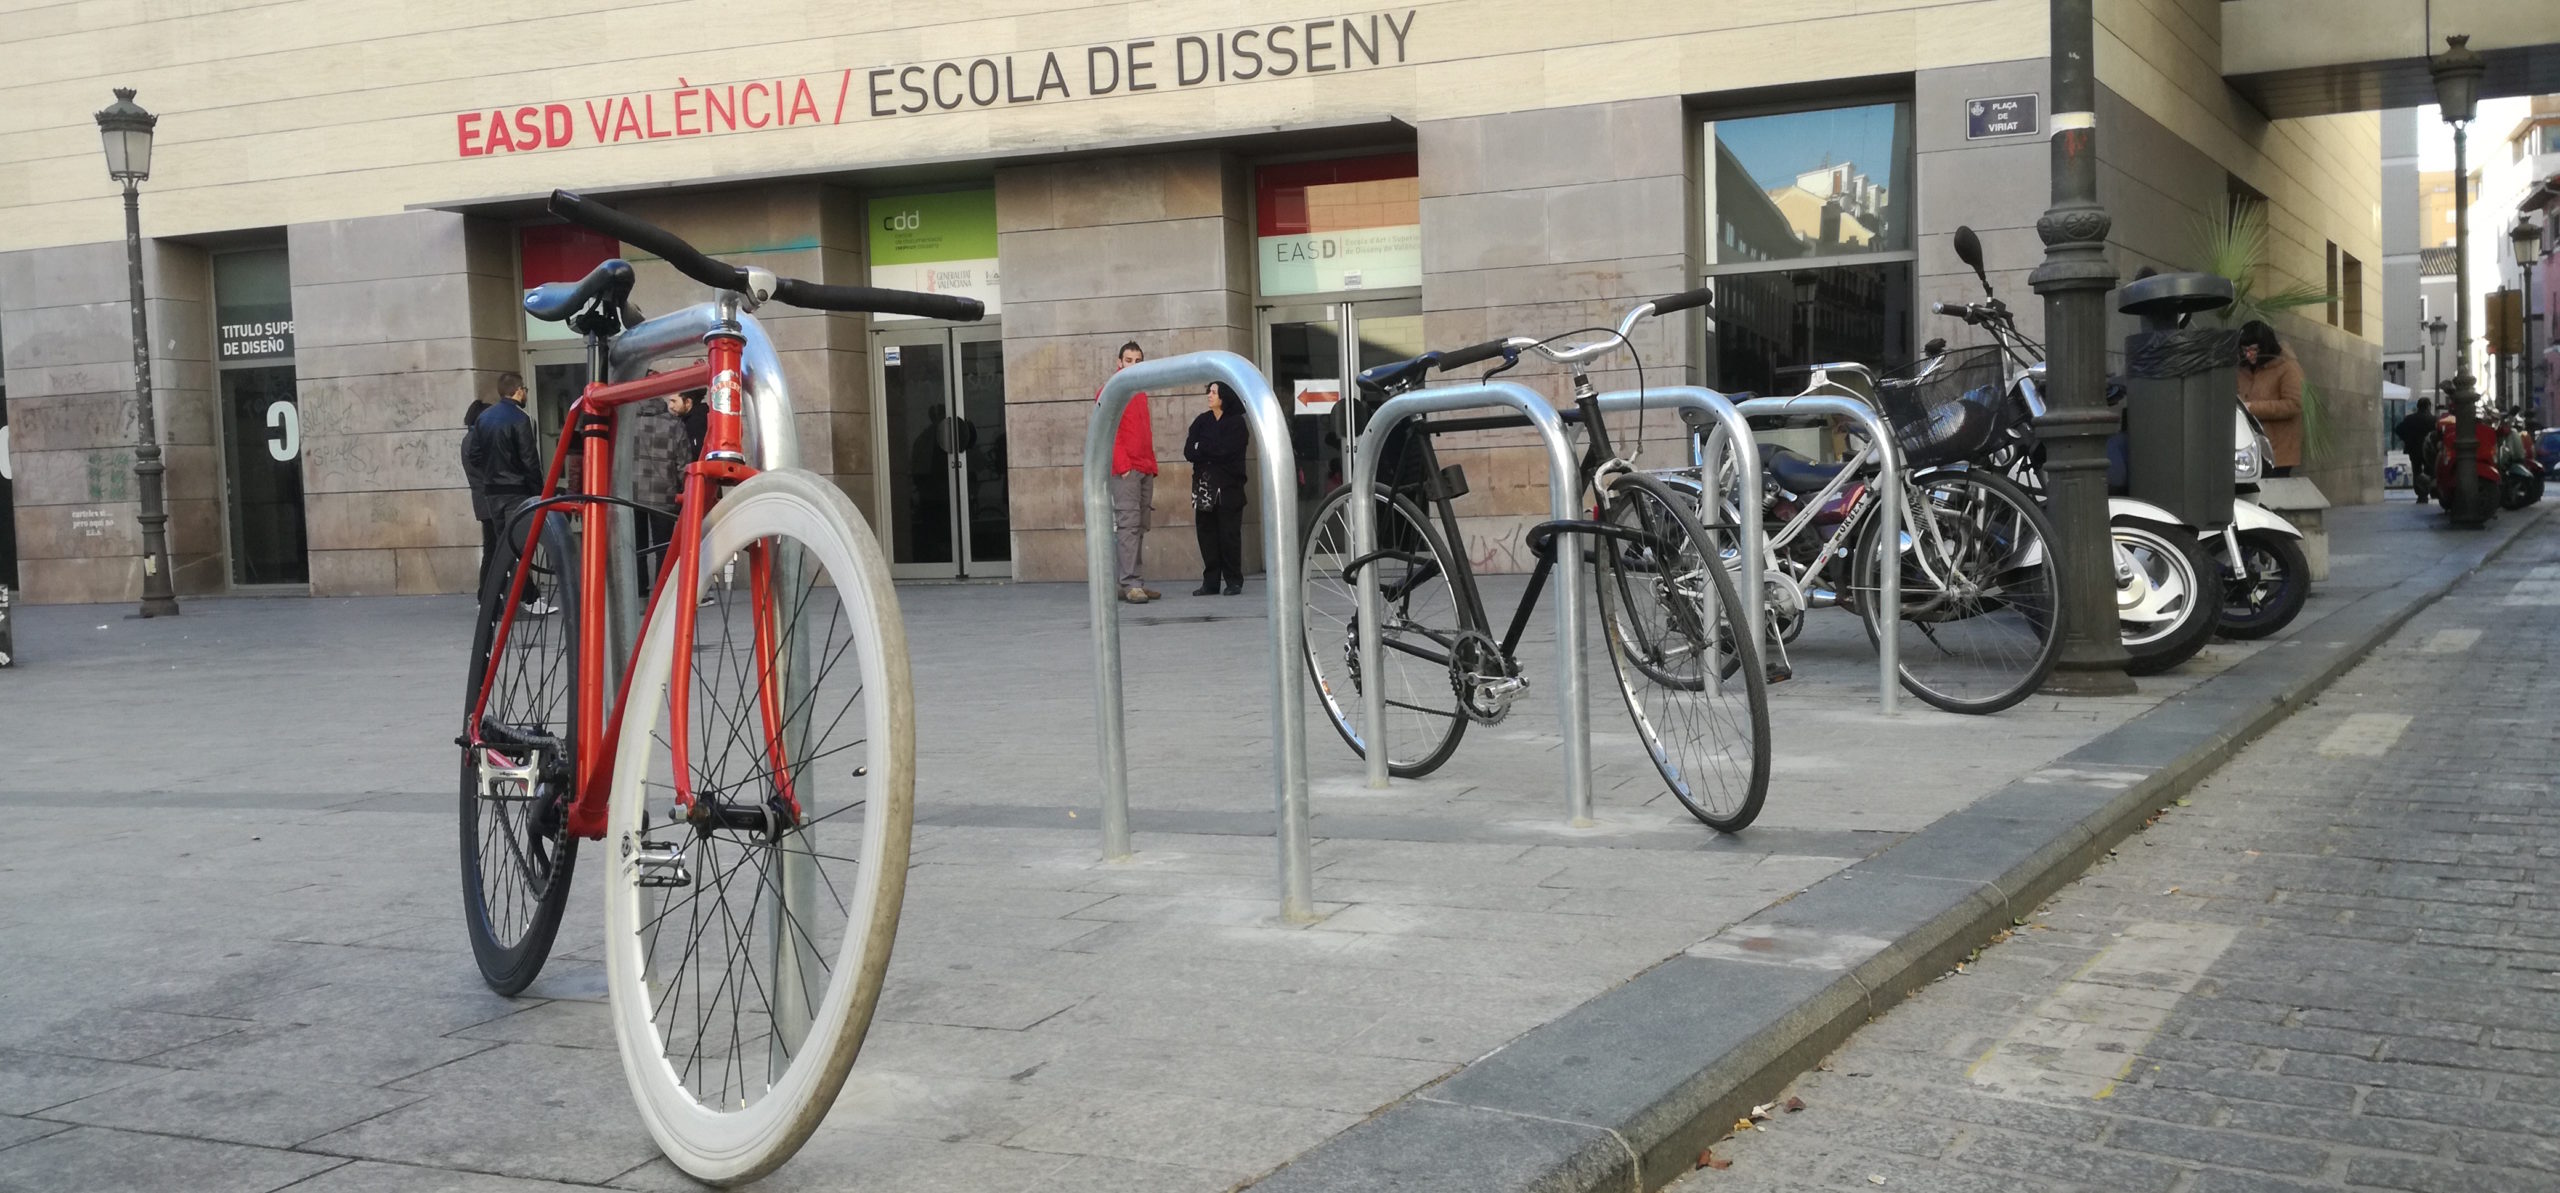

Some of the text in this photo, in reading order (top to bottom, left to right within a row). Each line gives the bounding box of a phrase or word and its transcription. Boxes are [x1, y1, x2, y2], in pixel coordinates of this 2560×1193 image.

[457, 10, 1416, 157] EASD VALÈNCIA / ESCOLA DE DISSENY
[1992, 102, 2018, 110] PLAÇA
[1997, 112, 2008, 120] DE
[1988, 121, 2018, 132] VIRIAT
[883, 210, 920, 231] cdd
[1277, 239, 1336, 262] EASD
[222, 323, 262, 338] TITULO
[224, 336, 284, 356] DE DISEÑO
[1840, 501, 1864, 532] ORBEA
